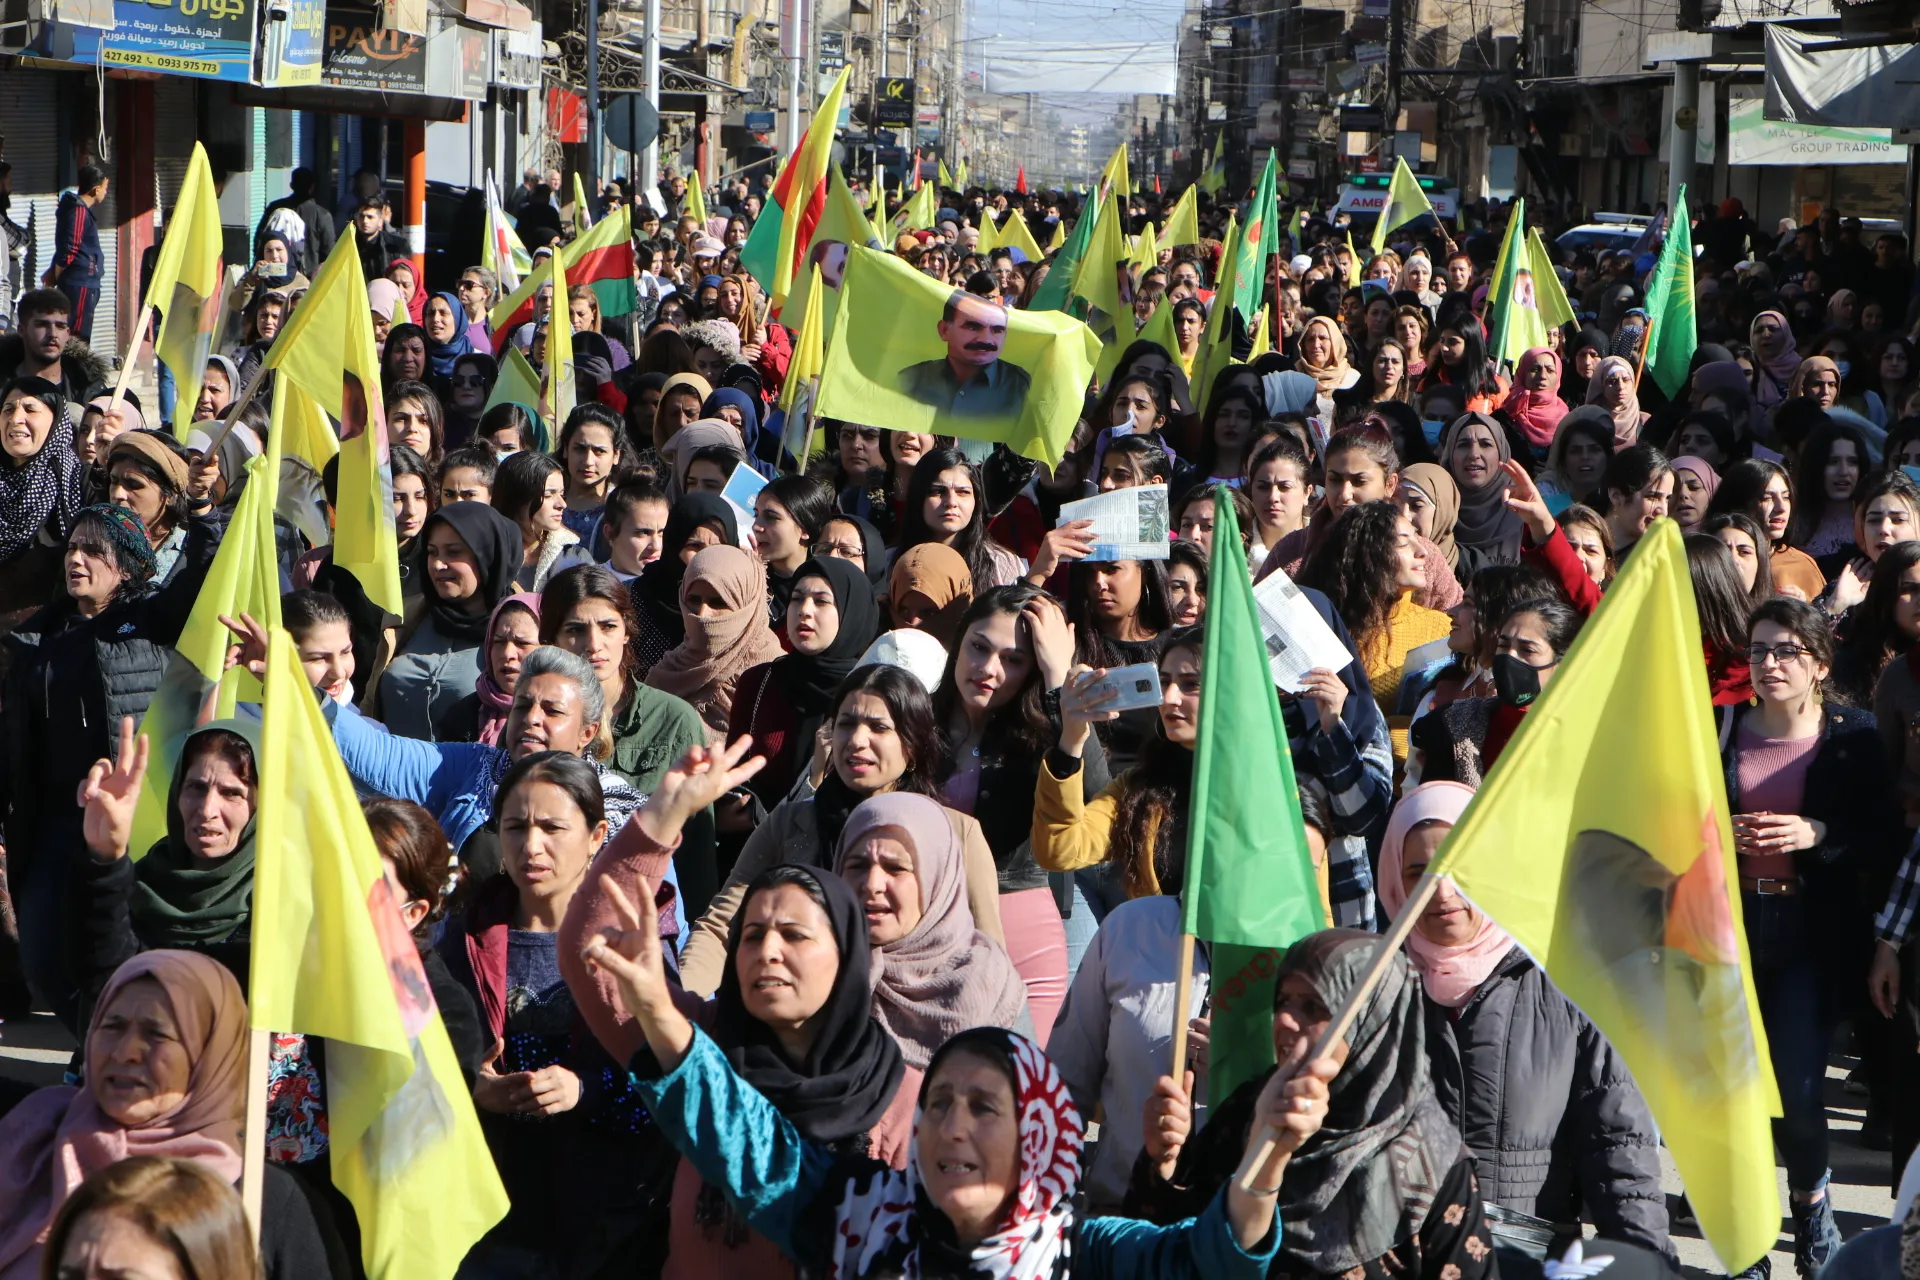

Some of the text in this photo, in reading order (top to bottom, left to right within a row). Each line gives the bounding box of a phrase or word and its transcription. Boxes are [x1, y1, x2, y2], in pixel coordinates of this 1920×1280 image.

[133, 19, 158, 32] برمجة
[164, 23, 191, 35] خطوط
[127, 33, 152, 44] صيانة
[158, 38, 178, 49] رصيد
[179, 40, 205, 50] تحويل
[104, 51, 217, 73] 427 492 0933 975 773
[1768, 128, 1794, 138] MAC
[1791, 143, 1832, 153] GROUP
